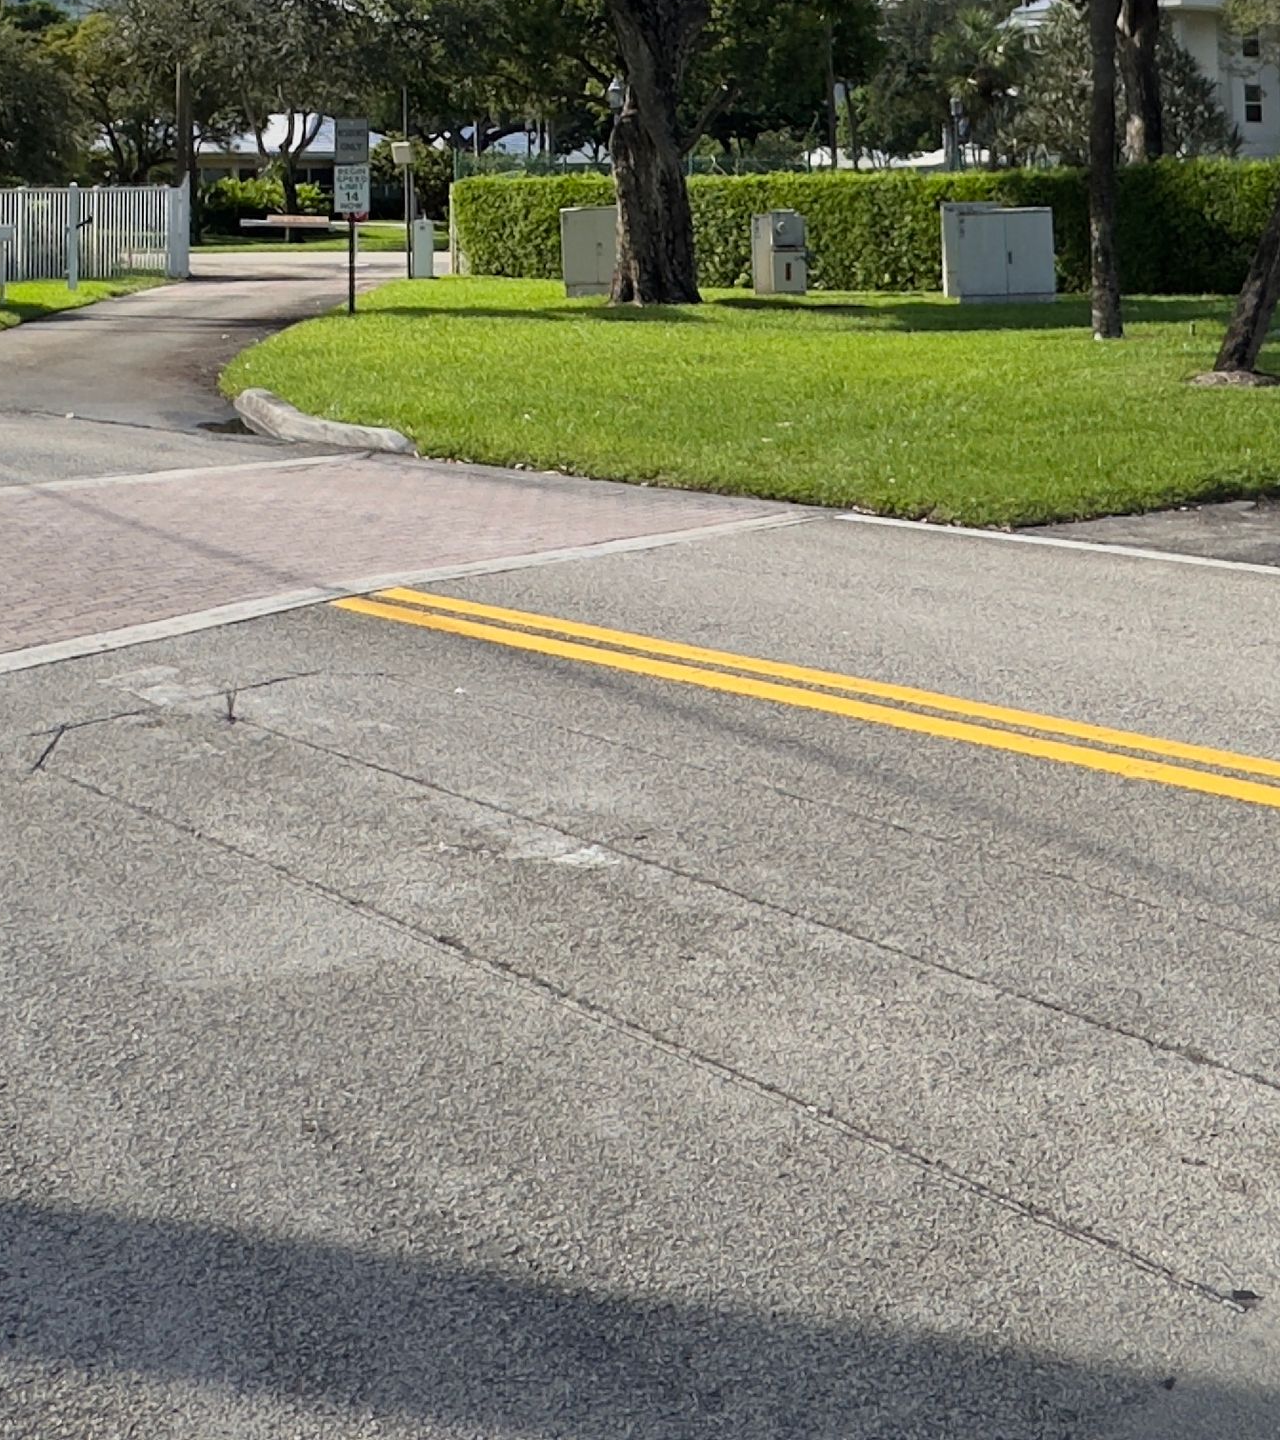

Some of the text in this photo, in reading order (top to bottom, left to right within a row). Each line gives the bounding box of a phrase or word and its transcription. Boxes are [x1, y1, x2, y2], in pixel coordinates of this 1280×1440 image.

[337, 167, 366, 175] BEGIN
[336, 175, 368, 183] SPEED
[339, 182, 364, 191] LIMIT
[344, 191, 360, 202] 14
[339, 202, 364, 210] NOW
